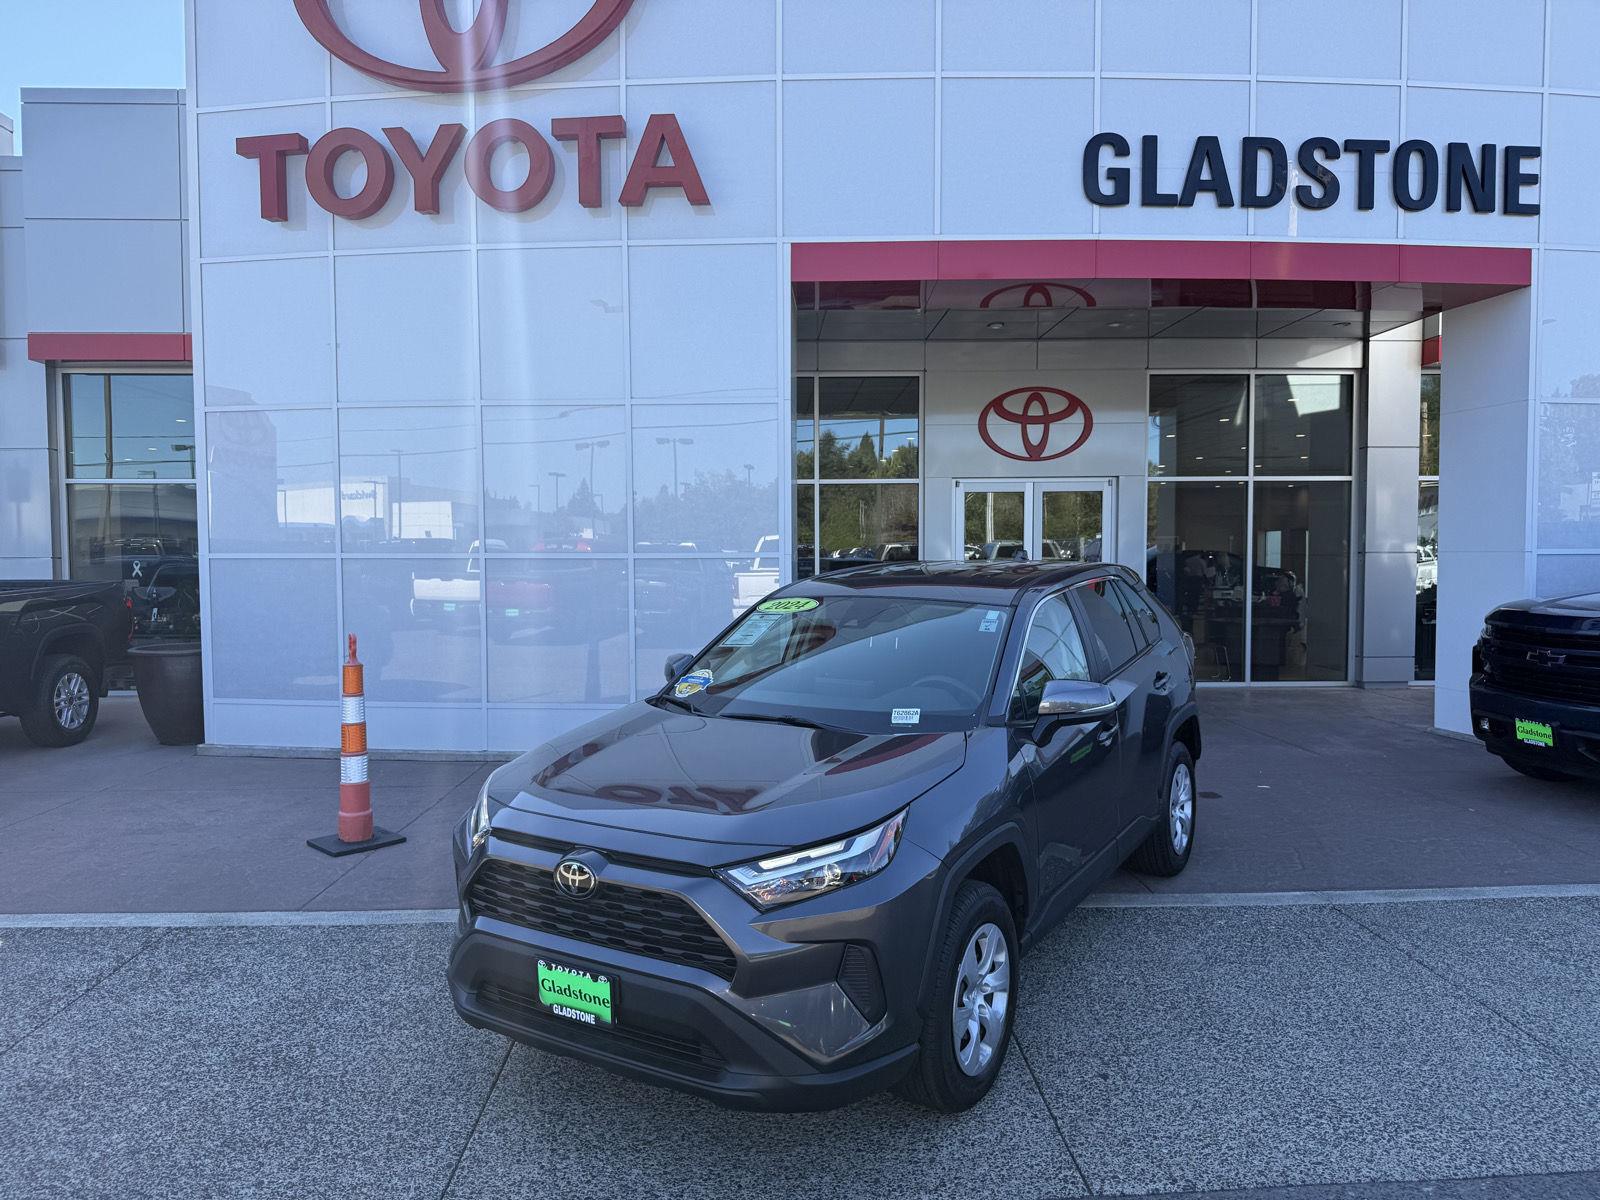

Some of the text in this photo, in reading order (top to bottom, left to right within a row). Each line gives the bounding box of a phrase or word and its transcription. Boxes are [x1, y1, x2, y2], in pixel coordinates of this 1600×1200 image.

[236, 113, 711, 222] TOYOTA
[1082, 132, 1540, 216] GLADSTONE
[764, 600, 812, 610] 2024
[1517, 726, 1552, 740] Gladstone
[550, 963, 592, 980] TOYOTA
[541, 978, 611, 1008] Gladstone
[553, 1004, 596, 1025] GLADSTONE
